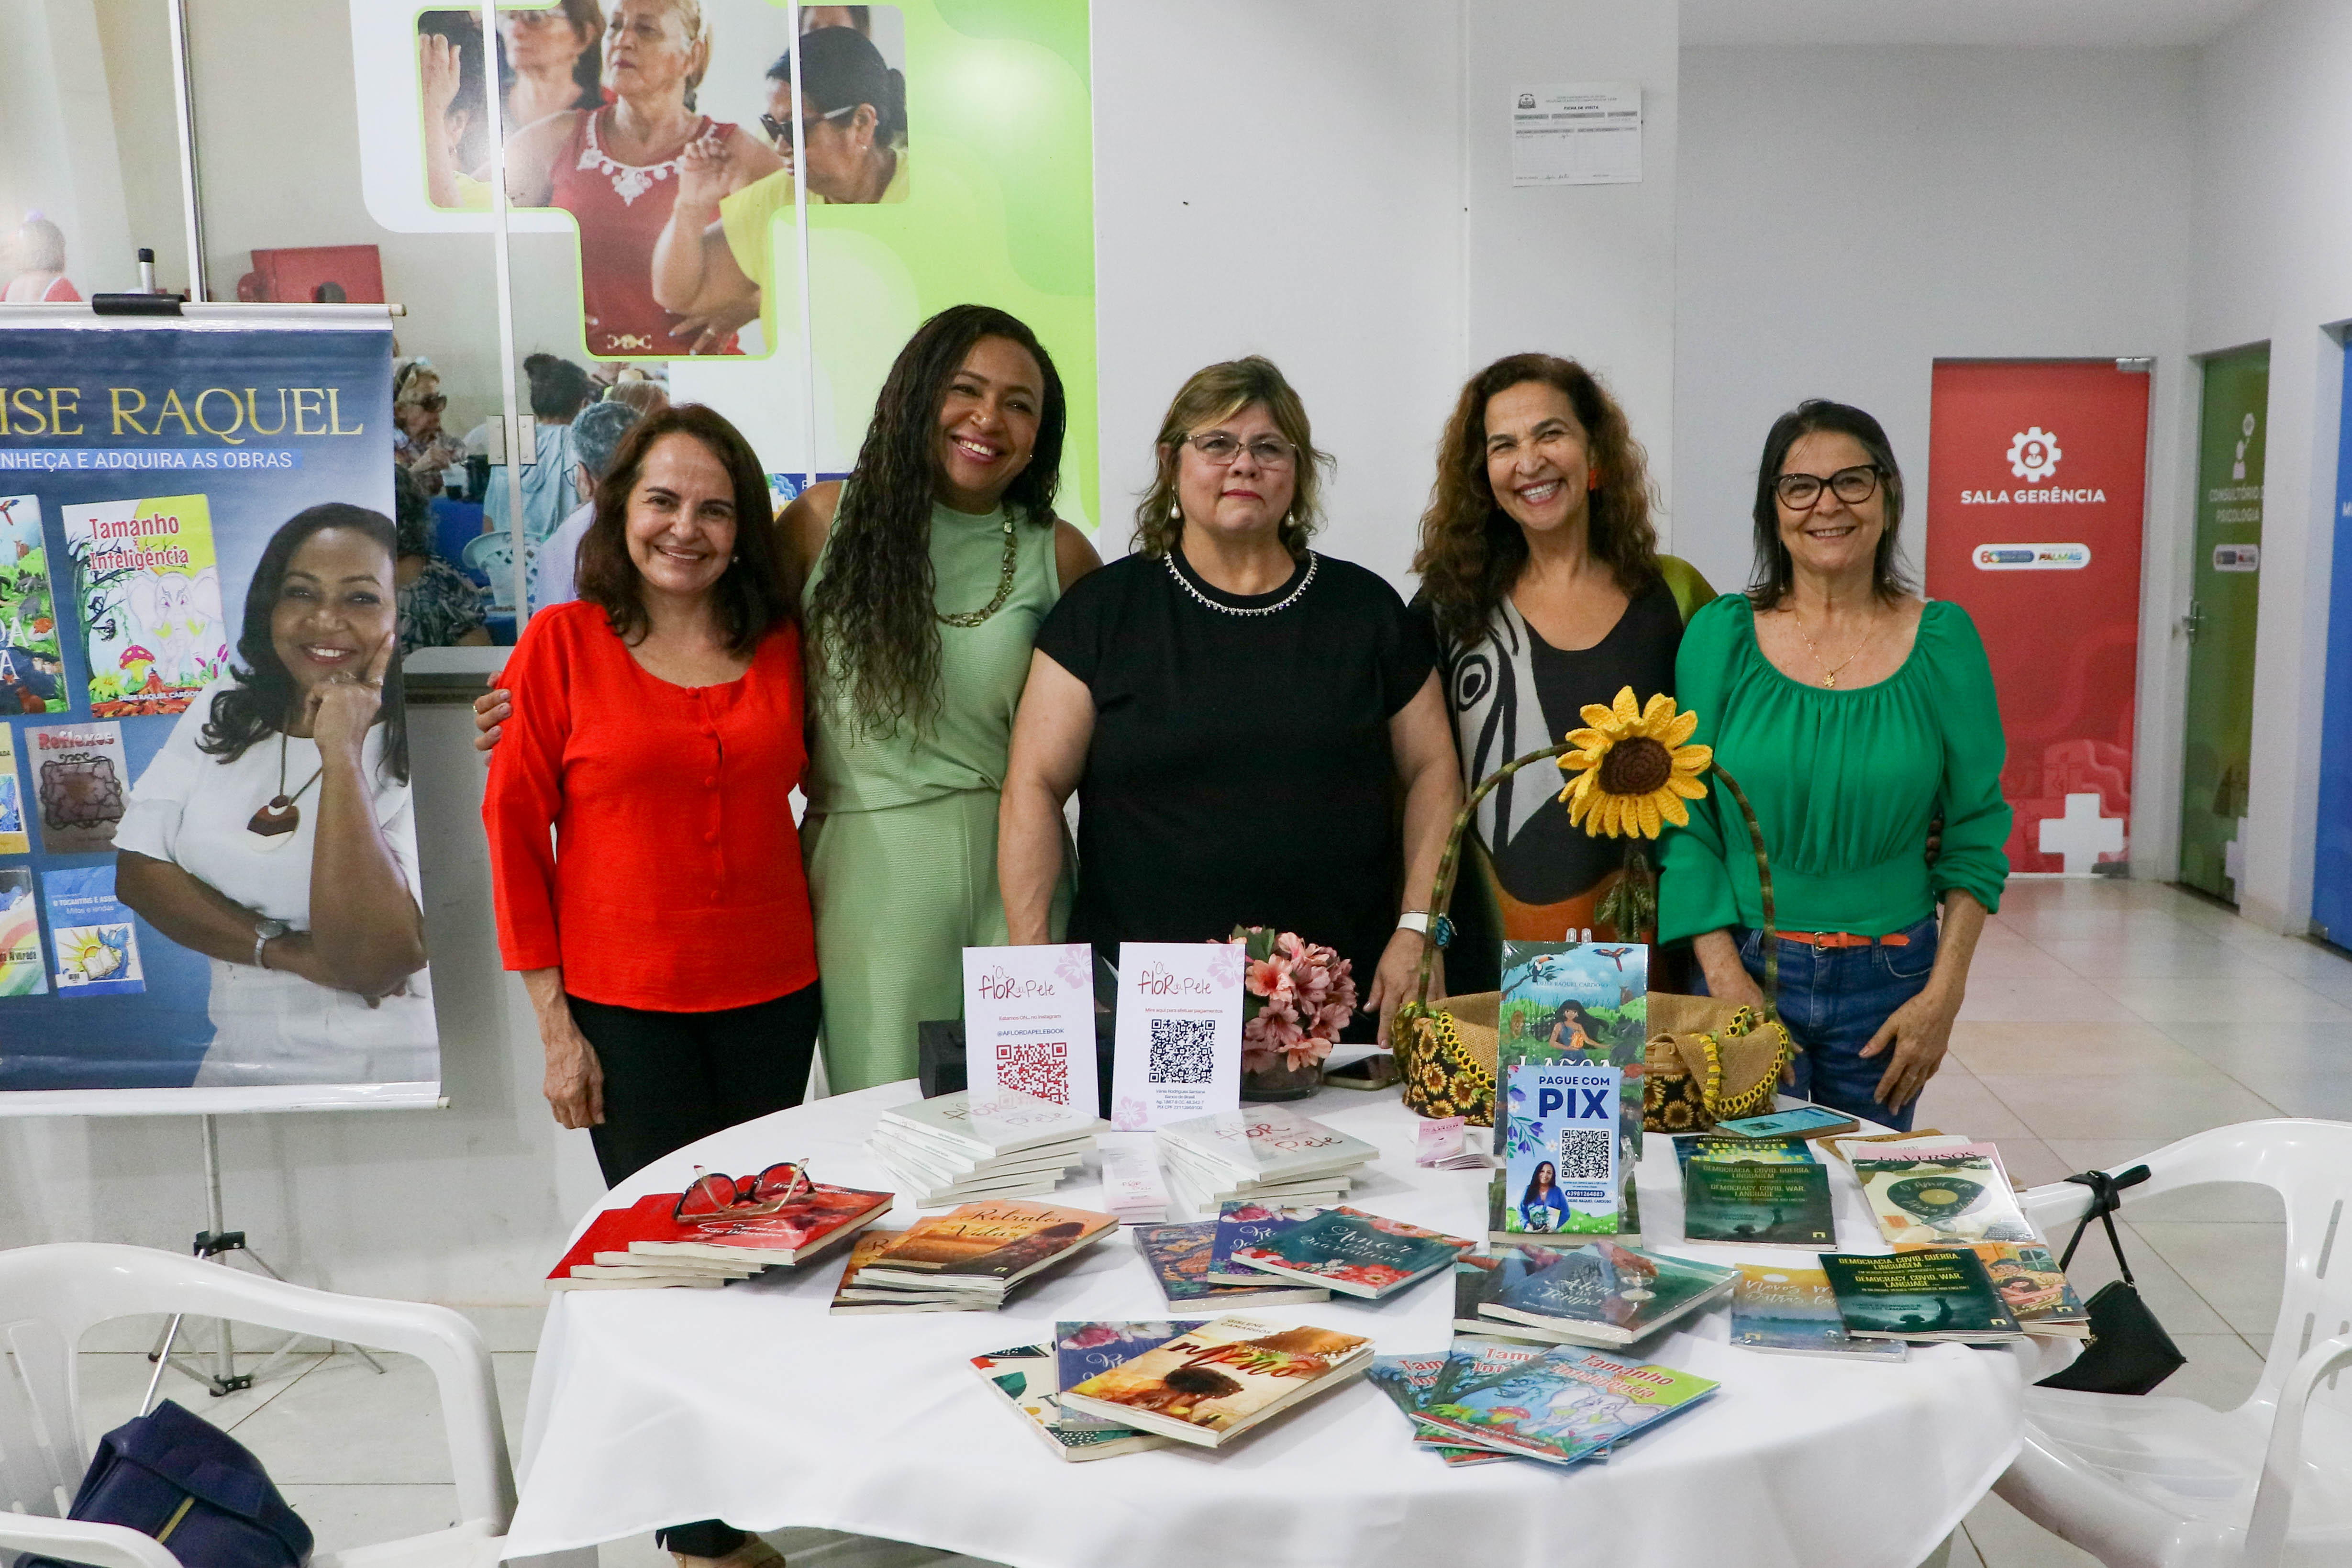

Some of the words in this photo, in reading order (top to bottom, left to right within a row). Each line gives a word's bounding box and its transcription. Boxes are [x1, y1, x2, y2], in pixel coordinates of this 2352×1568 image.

[109, 387, 364, 445] RAQUEL
[78, 452, 90, 468] E
[95, 452, 187, 470] ADQUIRA
[192, 452, 219, 468] AS
[223, 451, 293, 468] OBRAS
[1961, 489, 2010, 504] SALA
[2014, 486, 2107, 503] GERÊNCIA
[2216, 508, 2260, 522] PSICOLOGIA
[89, 513, 179, 540] Tamanho
[89, 545, 189, 570] Inteligência
[37, 731, 115, 750] Reflexos
[1025, 980, 1055, 998] Pele
[1184, 977, 1212, 995] Pele
[997, 1028, 1065, 1037] @AFLORDAPELEBOOK
[1539, 1076, 1579, 1085] PAGUE
[1582, 1077, 1610, 1086] COM
[1539, 1088, 1610, 1119] PIX
[1321, 1225, 1413, 1253] Amor
[1873, 1262, 1922, 1270] LINGUAGEM
[1220, 1322, 1272, 1334] CAMARGOS
[1227, 1318, 1265, 1327] GISLENE
[1581, 1354, 1674, 1386] Tamanho
[1550, 1364, 1656, 1398] Inteligência
[1507, 1434, 1547, 1447] CARDOSO
